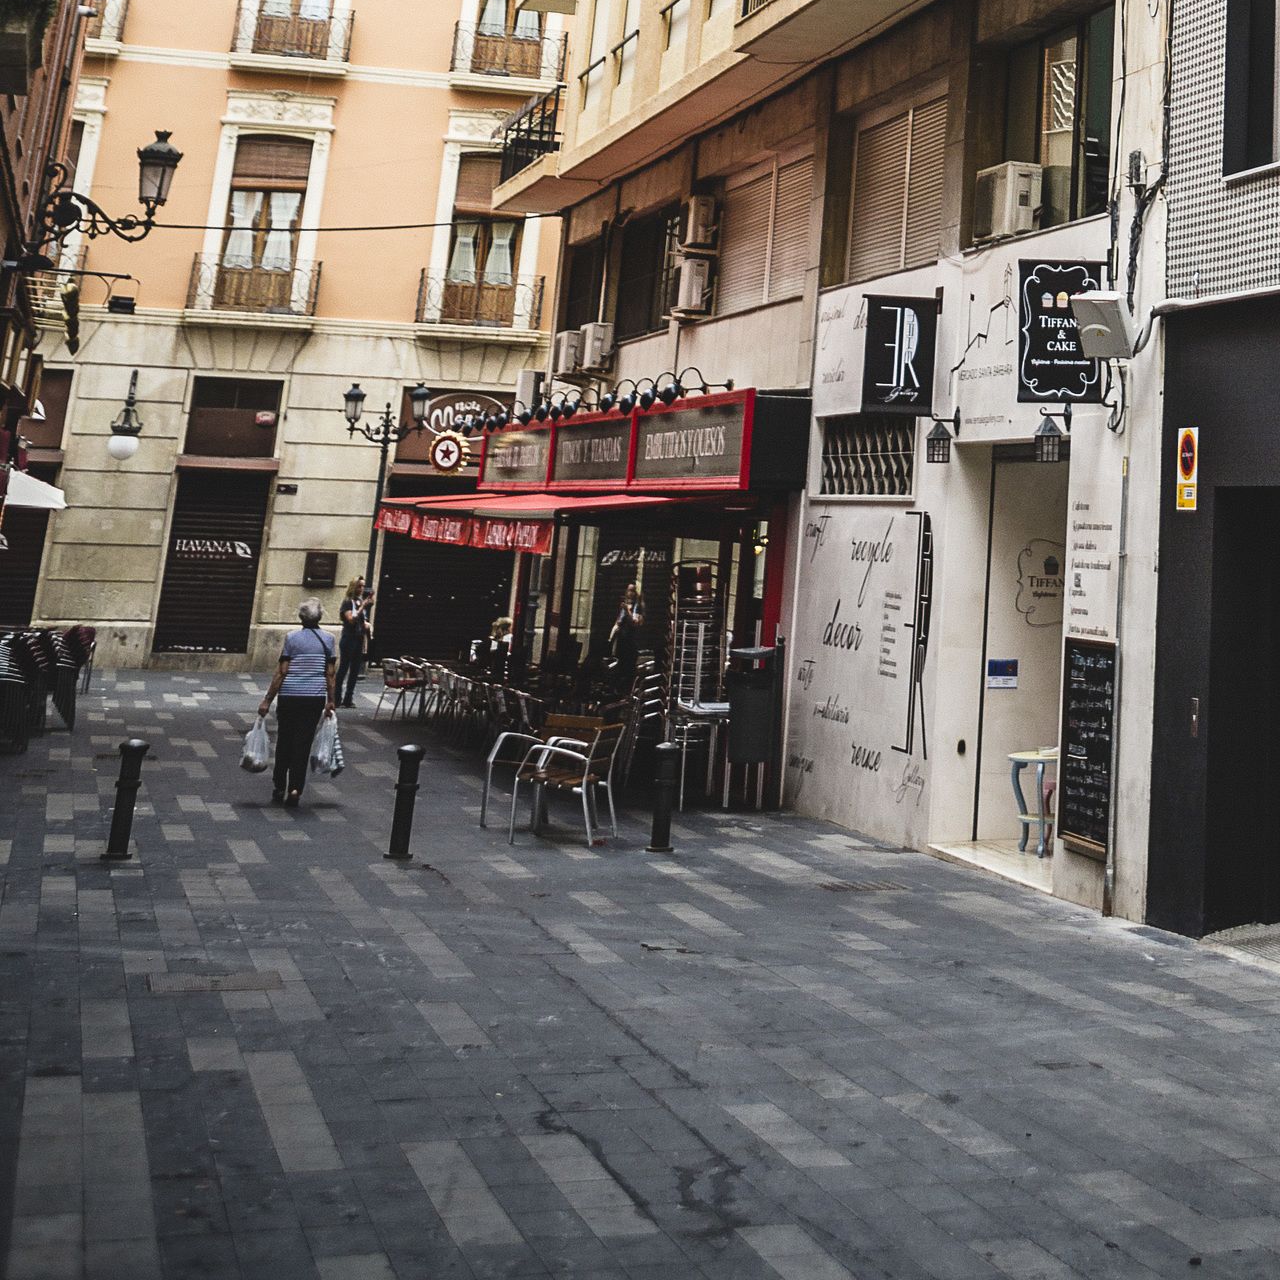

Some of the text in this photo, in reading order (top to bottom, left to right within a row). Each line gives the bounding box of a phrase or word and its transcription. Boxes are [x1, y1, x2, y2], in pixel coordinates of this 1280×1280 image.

[1039, 315, 1077, 328] TIFFAN
[1057, 330, 1066, 340] &
[1047, 341, 1076, 351] CAKE
[645, 426, 726, 465] EMBUTIDOS Y QUESOS
[176, 539, 233, 552] HAVANA
[851, 517, 894, 608] recycle
[1028, 576, 1065, 588] TIFFAN
[823, 599, 863, 651] decor
[851, 741, 882, 772] reuse
